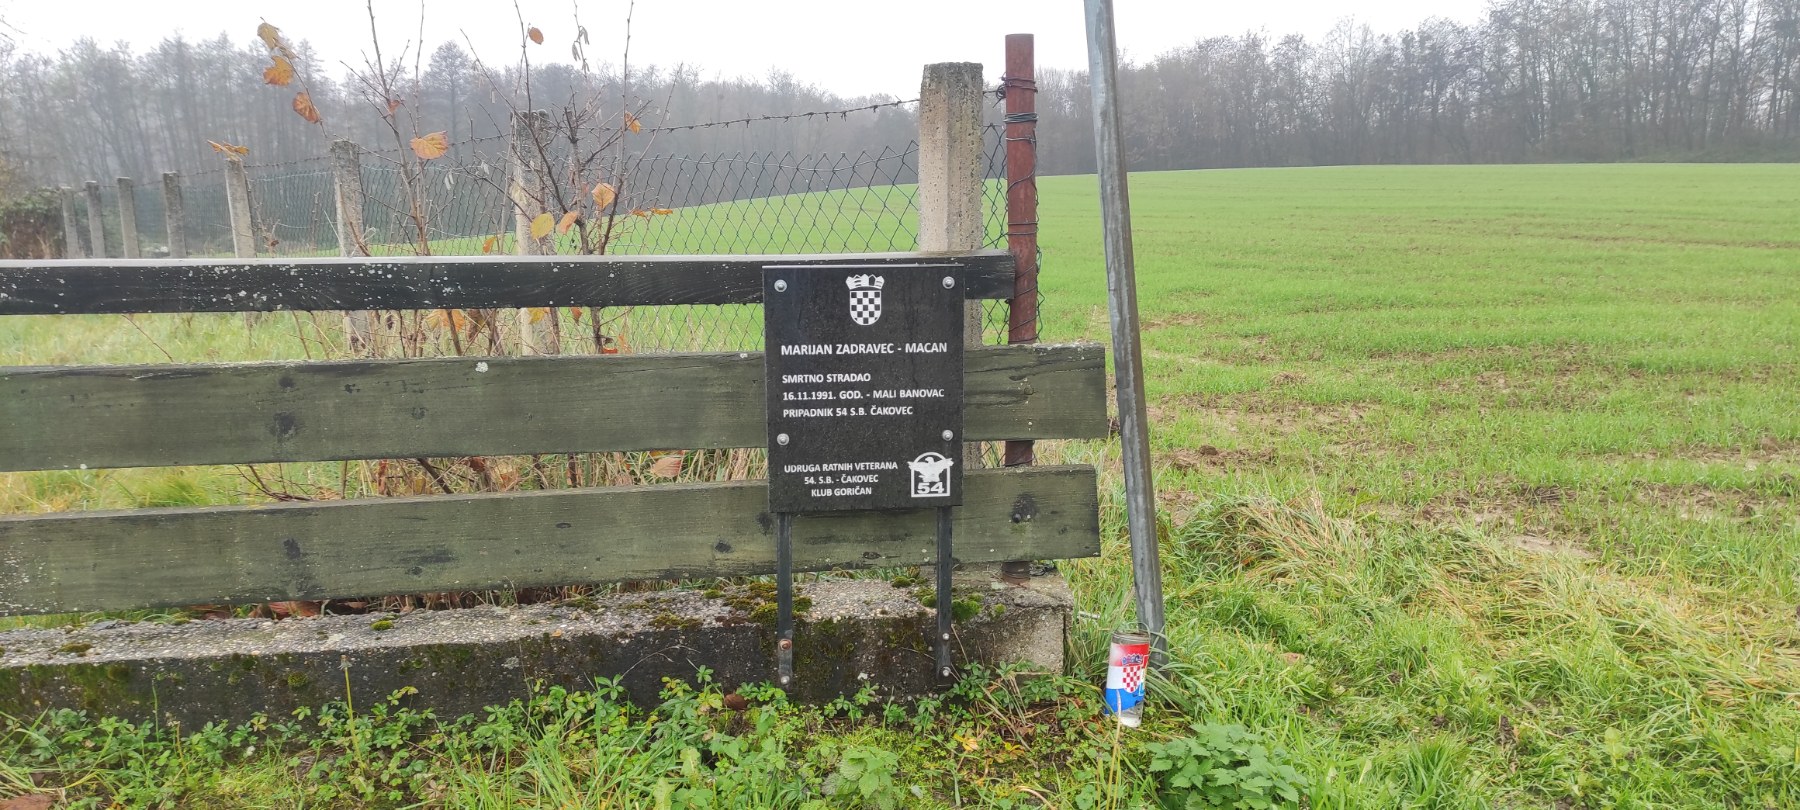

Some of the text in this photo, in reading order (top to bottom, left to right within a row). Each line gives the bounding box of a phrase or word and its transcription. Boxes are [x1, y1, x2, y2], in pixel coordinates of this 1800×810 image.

[781, 344, 832, 355] MARIJAN
[836, 343, 894, 354] ZADRAVEC
[905, 342, 947, 353] MACAN
[782, 373, 871, 383] SMRTNO STRADAO
[783, 391, 836, 400] 16.11.1991.
[839, 391, 863, 399] GOD.
[873, 390, 896, 398] MALI
[900, 389, 944, 398] BANOVAC
[783, 405, 913, 417] PRIPADNIK 54 S.B. ČAKOVEC
[784, 462, 898, 473] UDRUGA RATNIH VETERANA
[841, 474, 878, 483] ČAKOVEC
[834, 486, 872, 496] GORIČAN
[917, 482, 945, 494] 54
